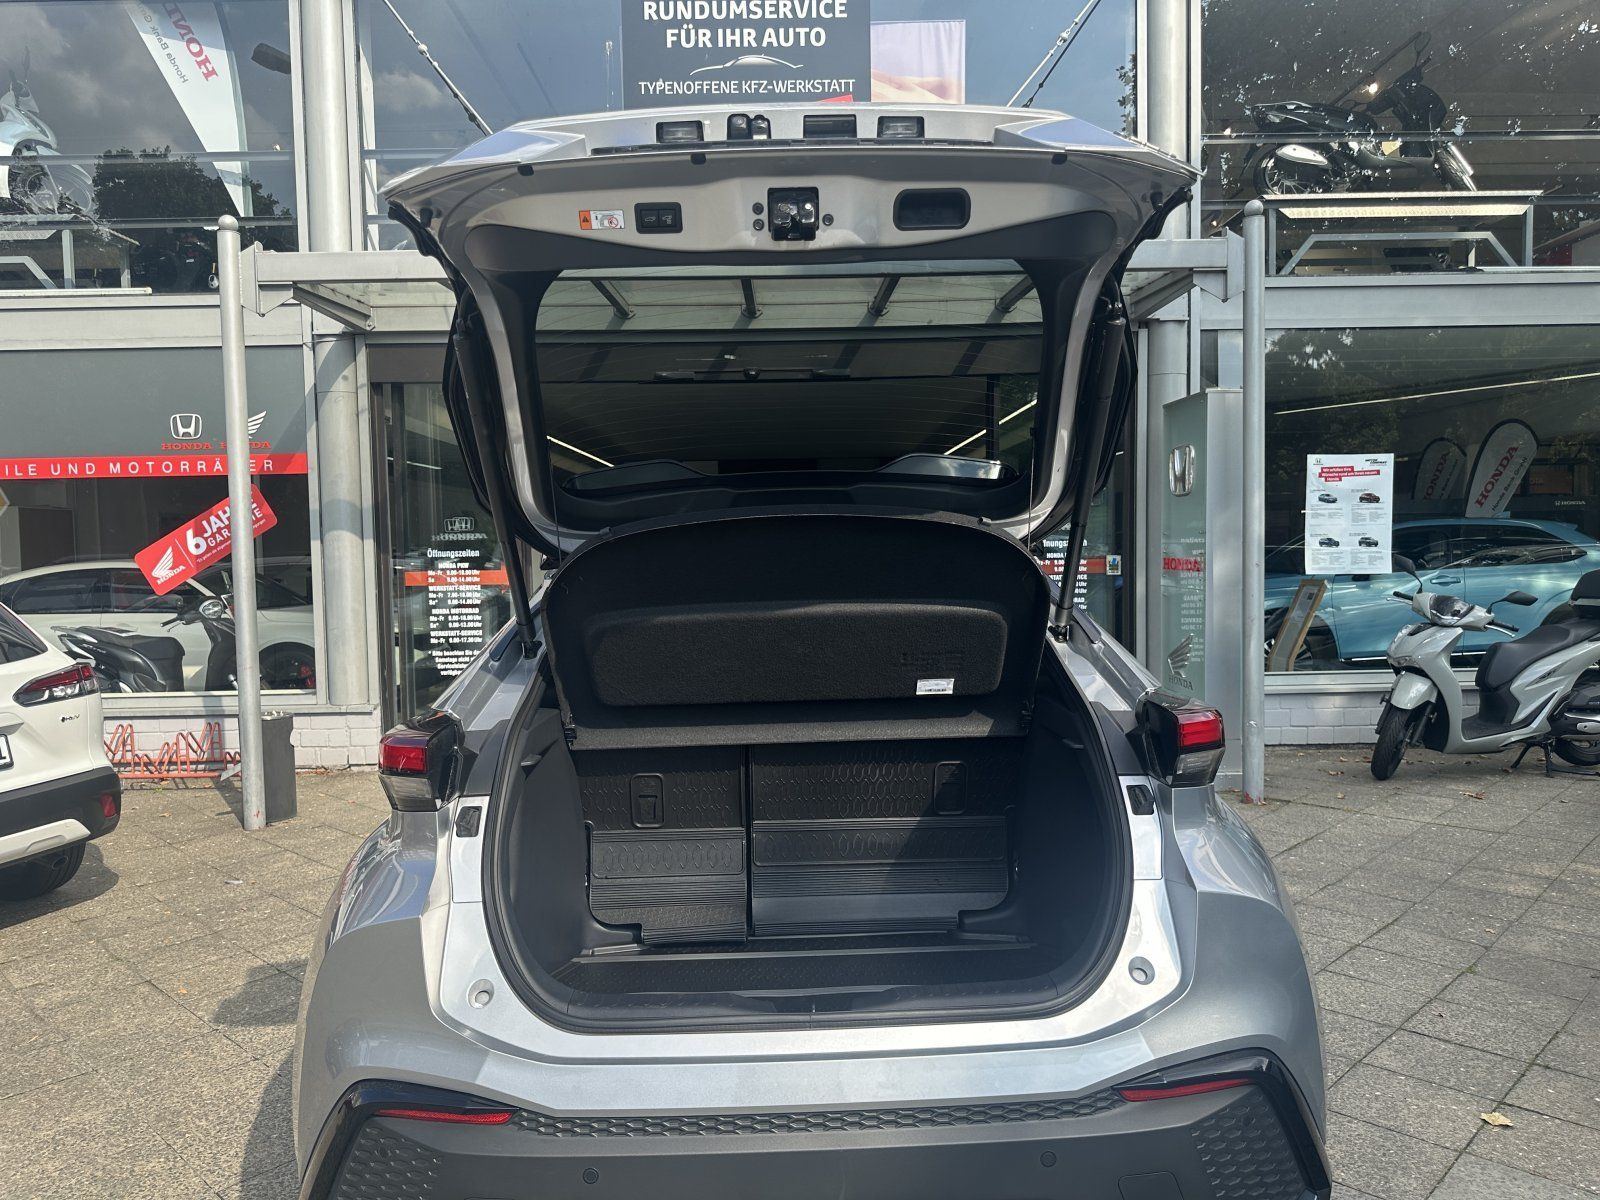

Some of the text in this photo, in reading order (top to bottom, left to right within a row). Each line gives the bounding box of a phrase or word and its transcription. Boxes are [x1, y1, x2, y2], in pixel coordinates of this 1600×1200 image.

[643, 0, 849, 21] RUNDUMSERVICE
[666, 24, 826, 49] FÜR IHR AUTO
[638, 79, 856, 96] TYPENOFFENE KFZ-WERKSTATT
[161, 442, 213, 450] HONDA
[50, 462, 96, 475] UND
[109, 457, 274, 475] MOTORRÄER
[1474, 446, 1519, 507] HONDA
[186, 527, 207, 556] 6
[427, 548, 480, 559] Öffnungszeiten
[156, 565, 186, 585] HONDA
[1168, 676, 1193, 691] HONDA
